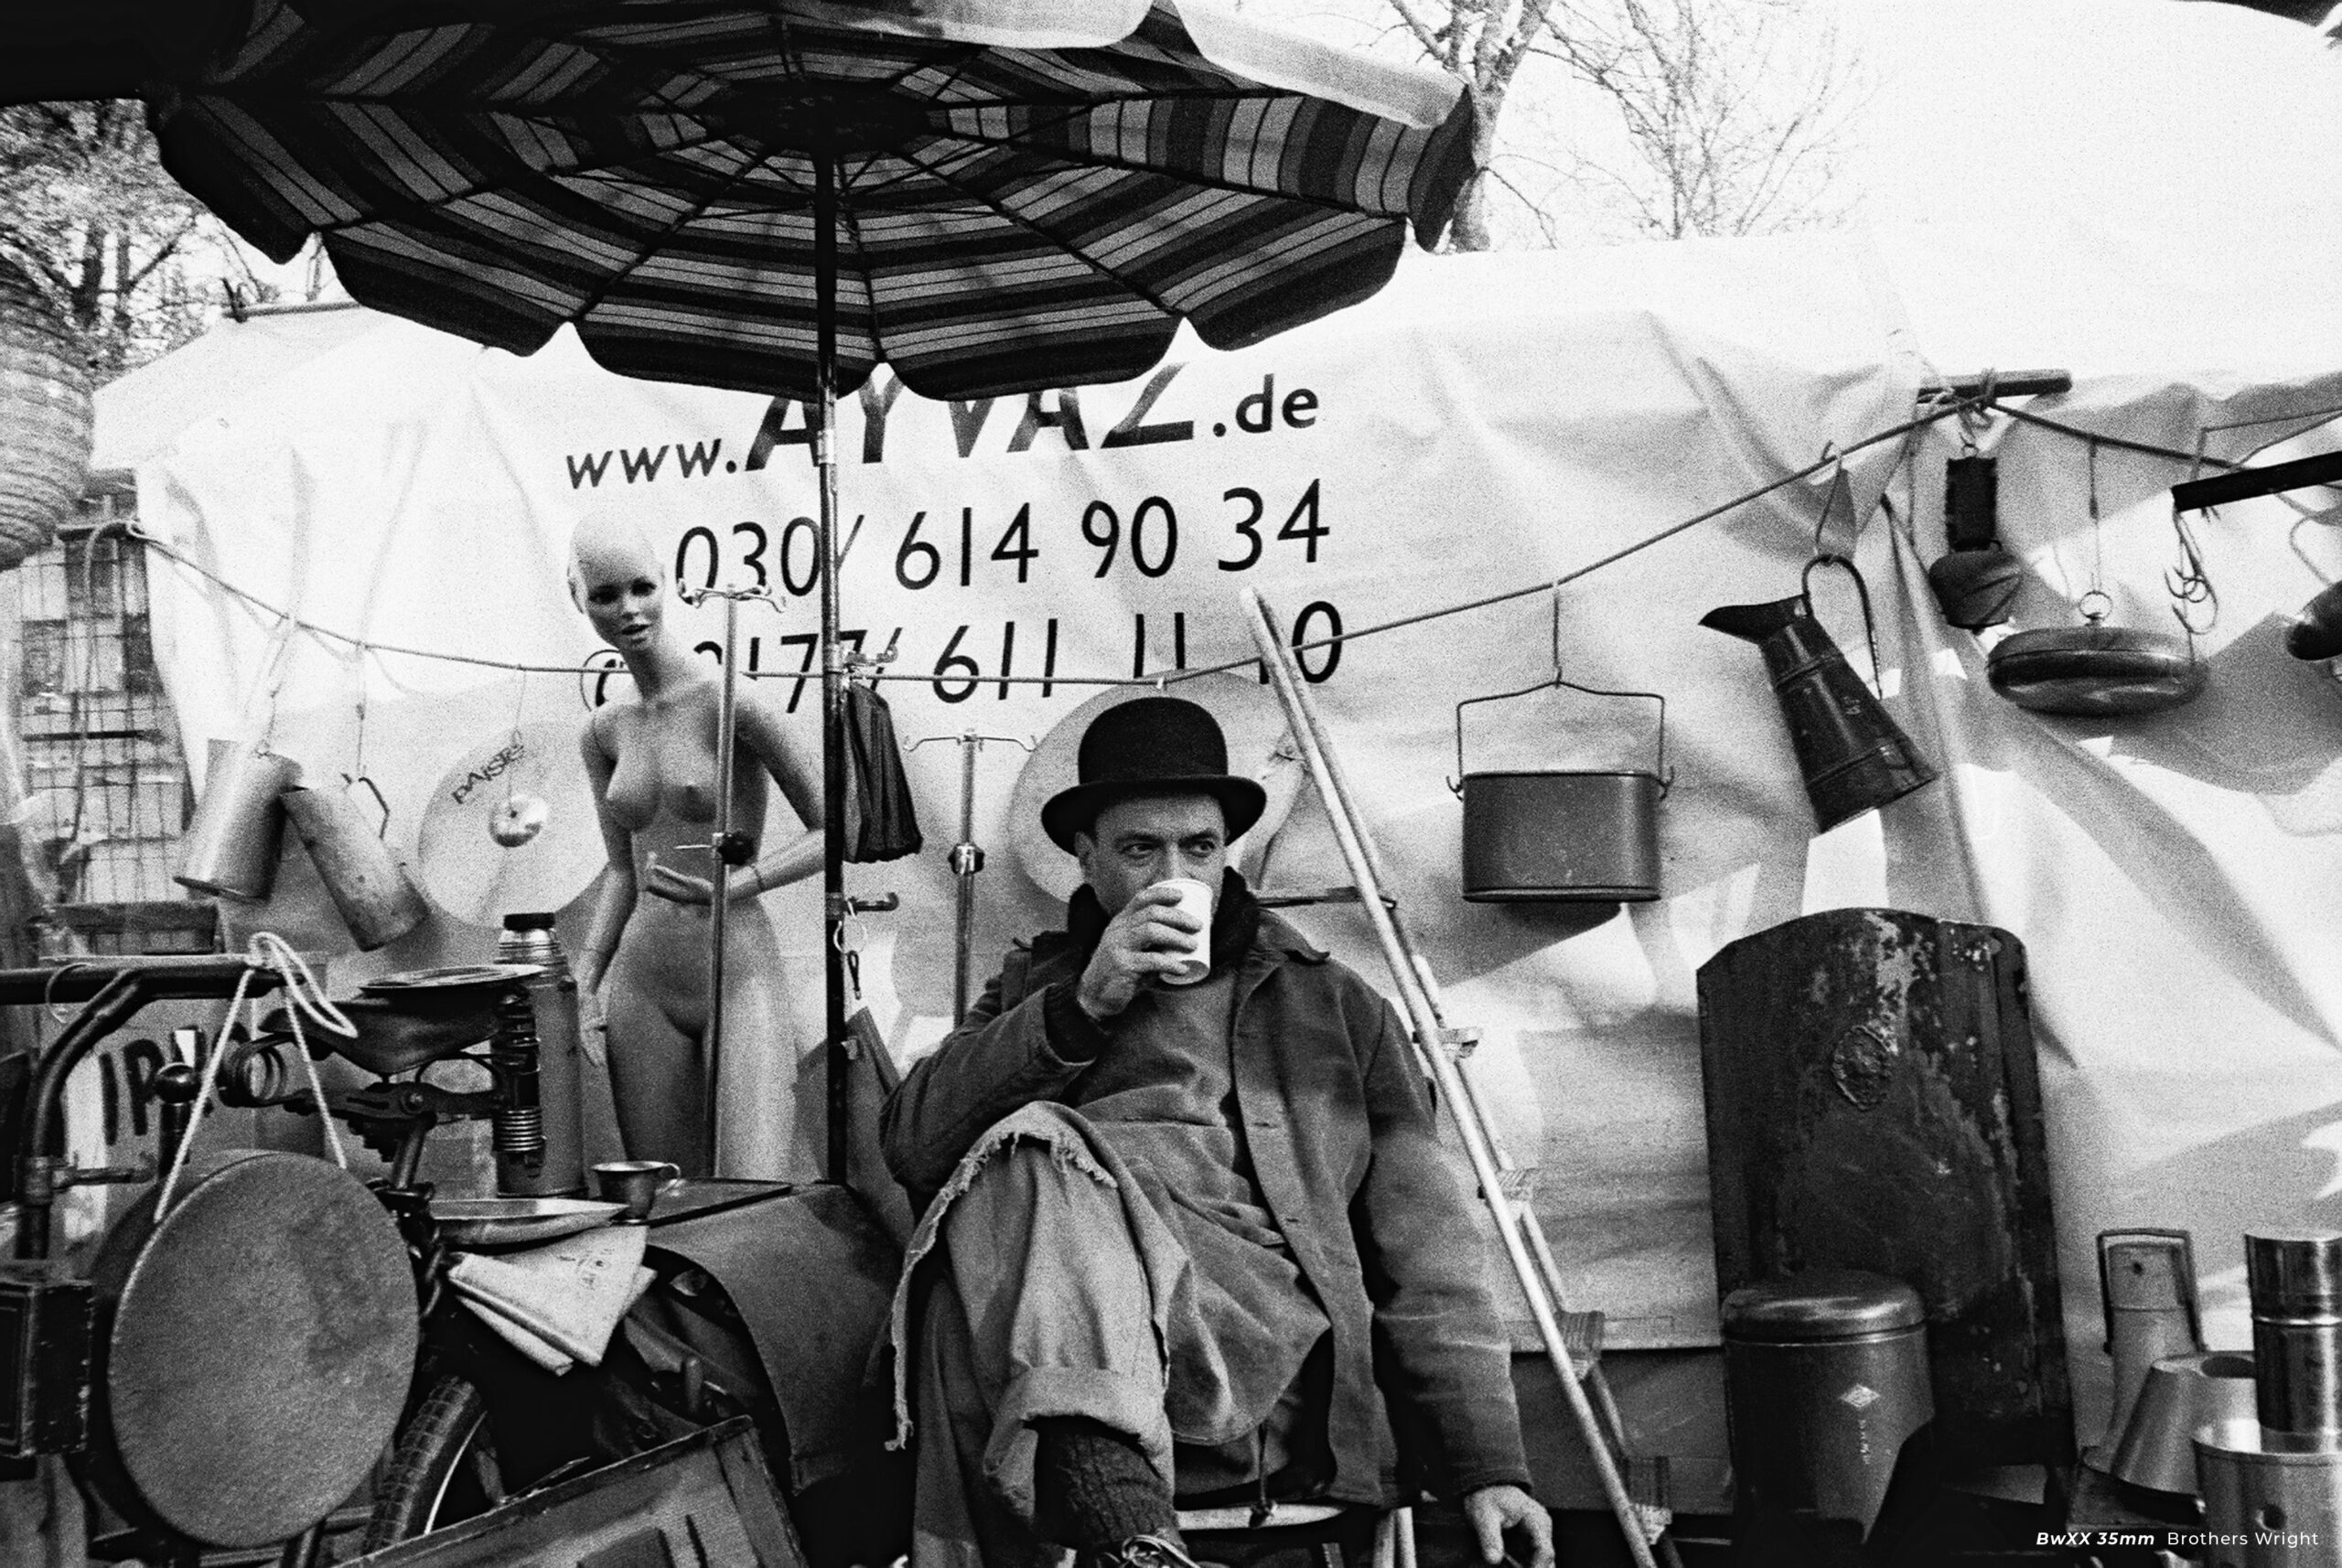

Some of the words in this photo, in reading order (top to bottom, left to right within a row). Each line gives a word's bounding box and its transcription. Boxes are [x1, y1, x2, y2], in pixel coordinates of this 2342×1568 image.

[896, 501, 1039, 591] 614
[1080, 495, 1178, 579] 90
[1218, 478, 1330, 572] 34
[932, 618, 1058, 704] 611
